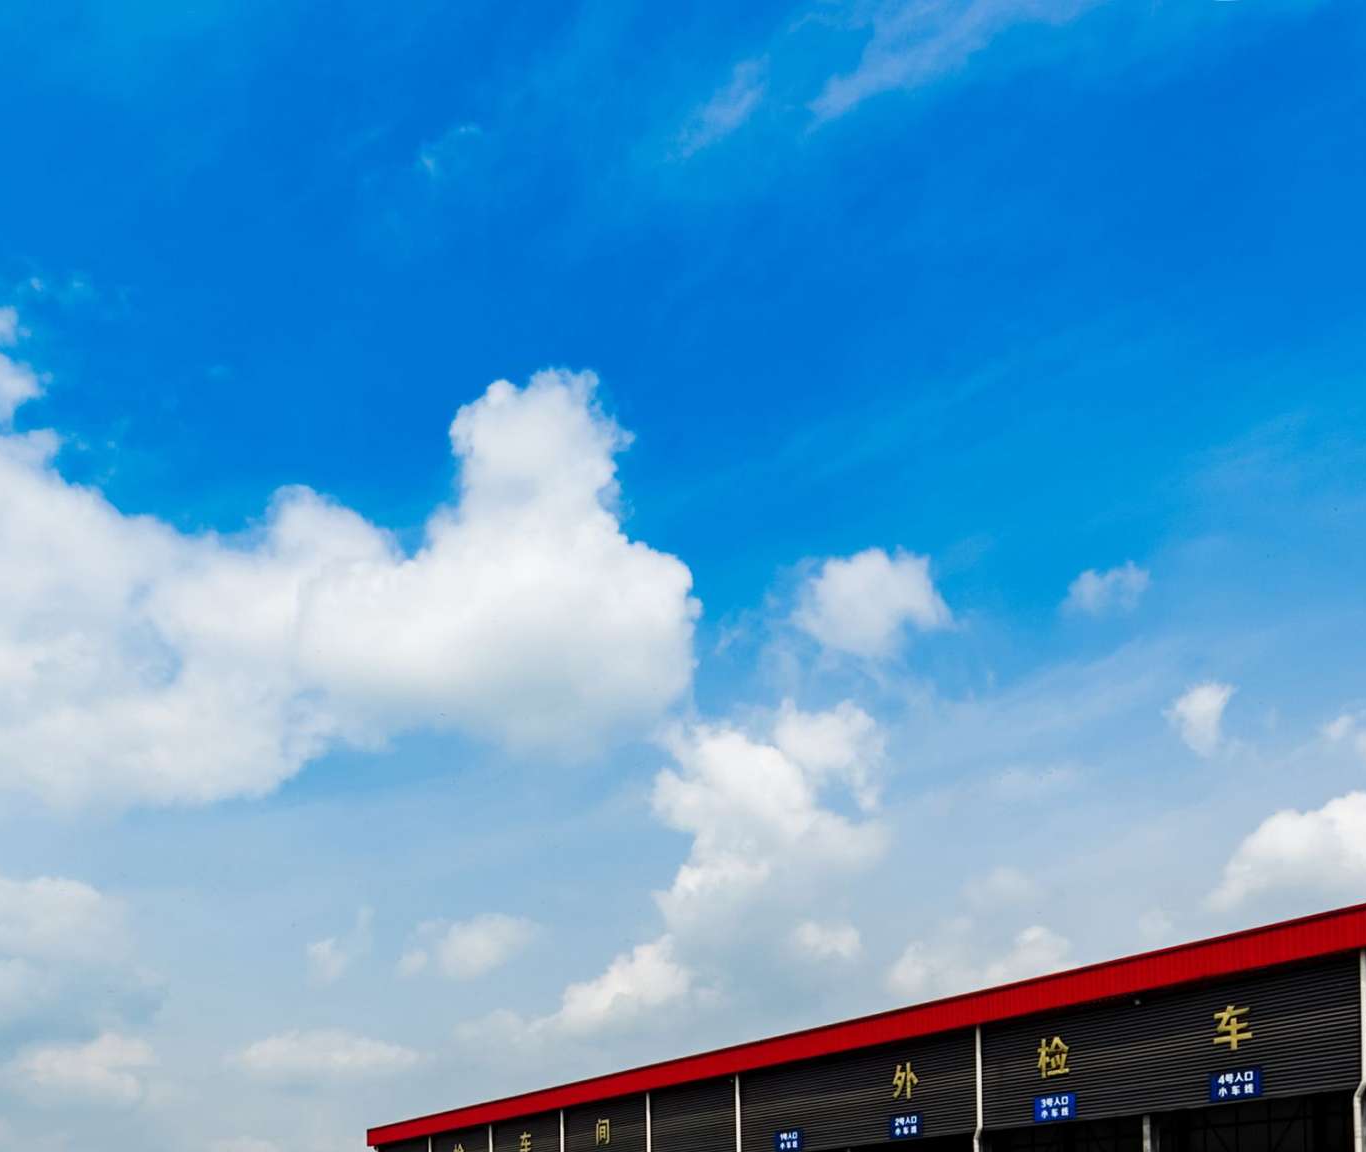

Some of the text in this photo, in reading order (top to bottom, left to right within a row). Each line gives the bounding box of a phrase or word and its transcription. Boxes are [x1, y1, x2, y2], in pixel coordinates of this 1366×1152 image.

[1217, 1070, 1254, 1085] 4号入口
[1218, 1083, 1254, 1097] 小车线
[1040, 1095, 1069, 1108] 3号入口
